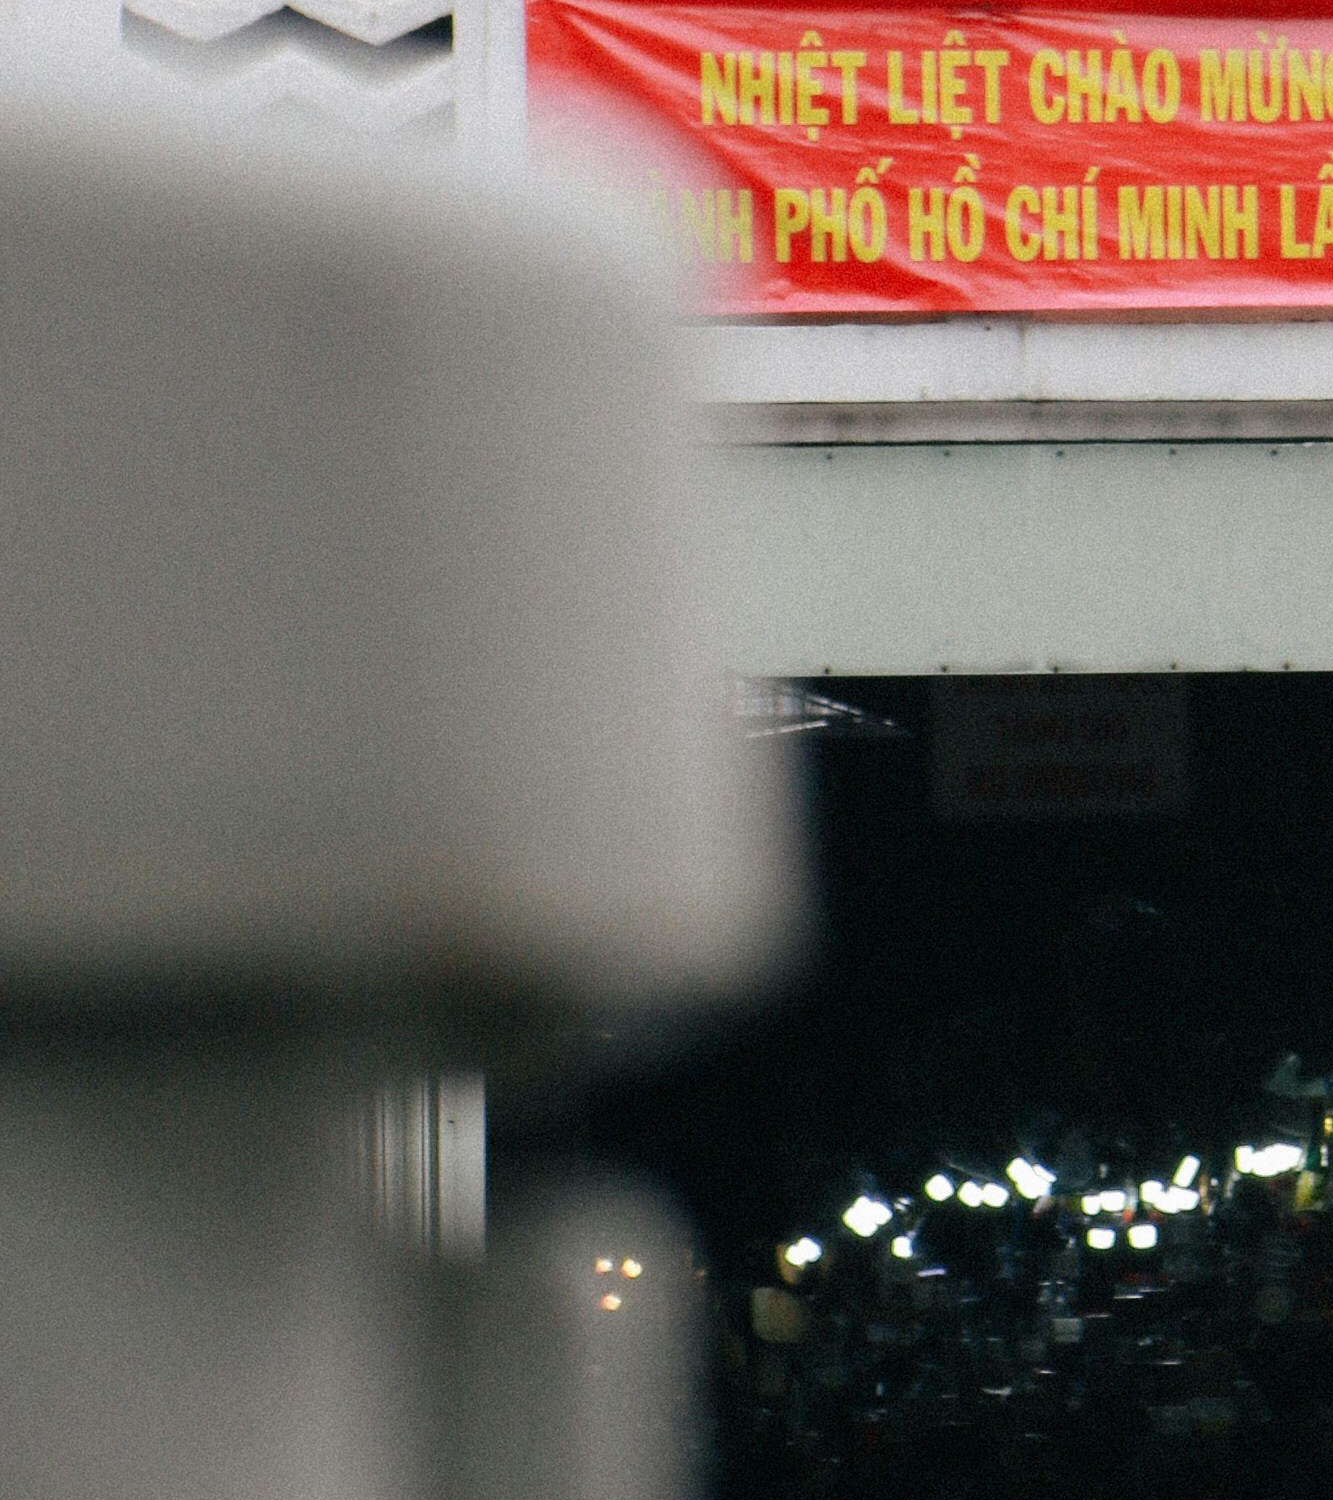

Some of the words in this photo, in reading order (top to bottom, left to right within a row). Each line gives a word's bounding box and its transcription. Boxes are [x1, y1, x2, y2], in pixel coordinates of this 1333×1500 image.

[699, 29, 866, 141] NHIỆT
[886, 28, 1010, 140] LIỆT
[1027, 29, 1182, 125] CHÀO
[773, 156, 891, 264] PHỐ
[907, 152, 987, 263] HỒ
[1003, 165, 1101, 263] CHÍ
[1116, 182, 1260, 261] MINH
